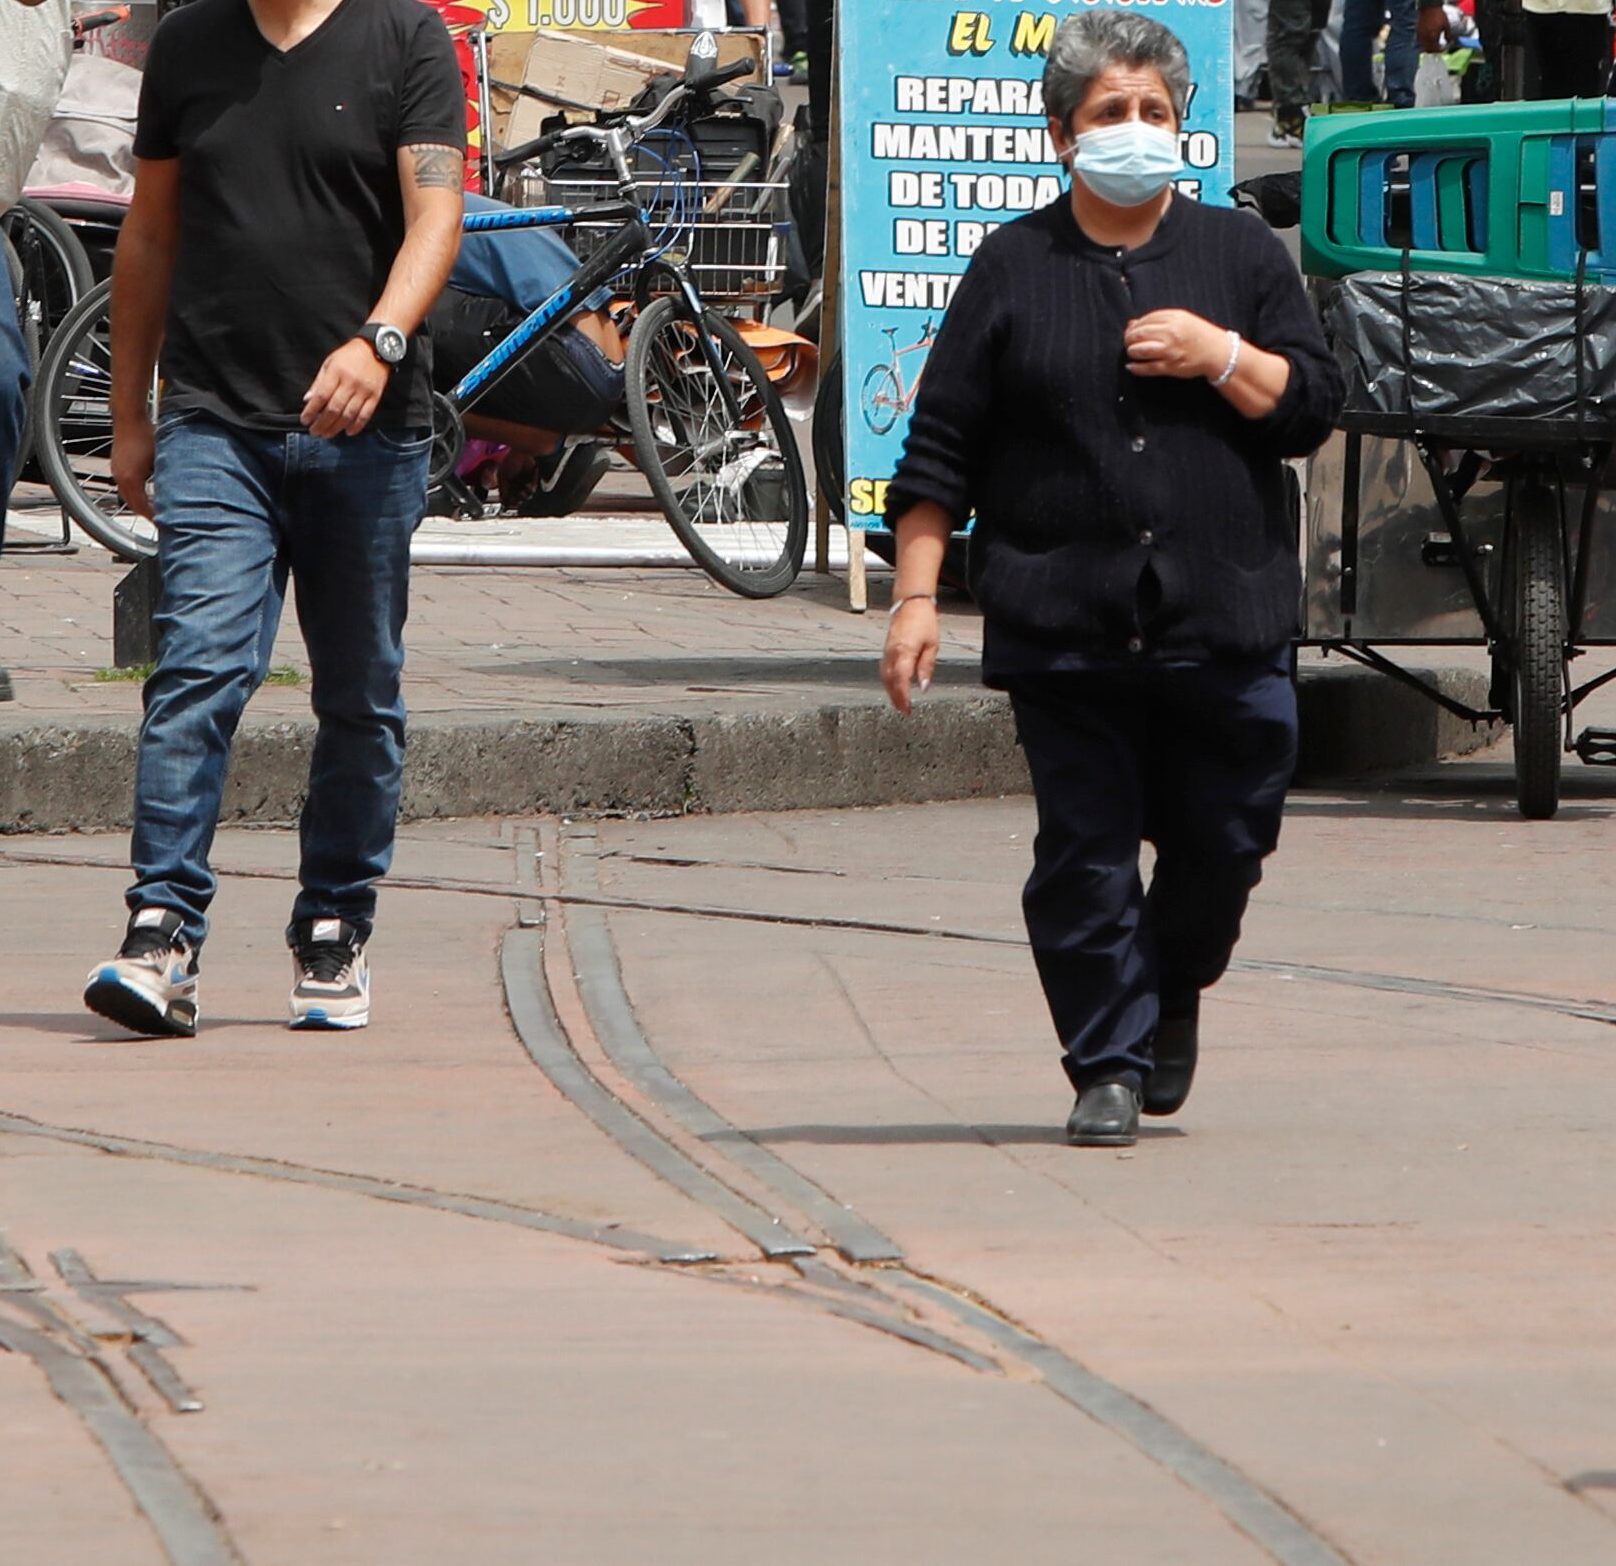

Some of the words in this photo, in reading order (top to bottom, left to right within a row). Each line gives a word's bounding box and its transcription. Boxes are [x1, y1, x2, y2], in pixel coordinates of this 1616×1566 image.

[949, 11, 994, 55] EL
[896, 76, 1045, 116] REPARA
[889, 171, 944, 207] DE
[894, 218, 948, 255] DE
